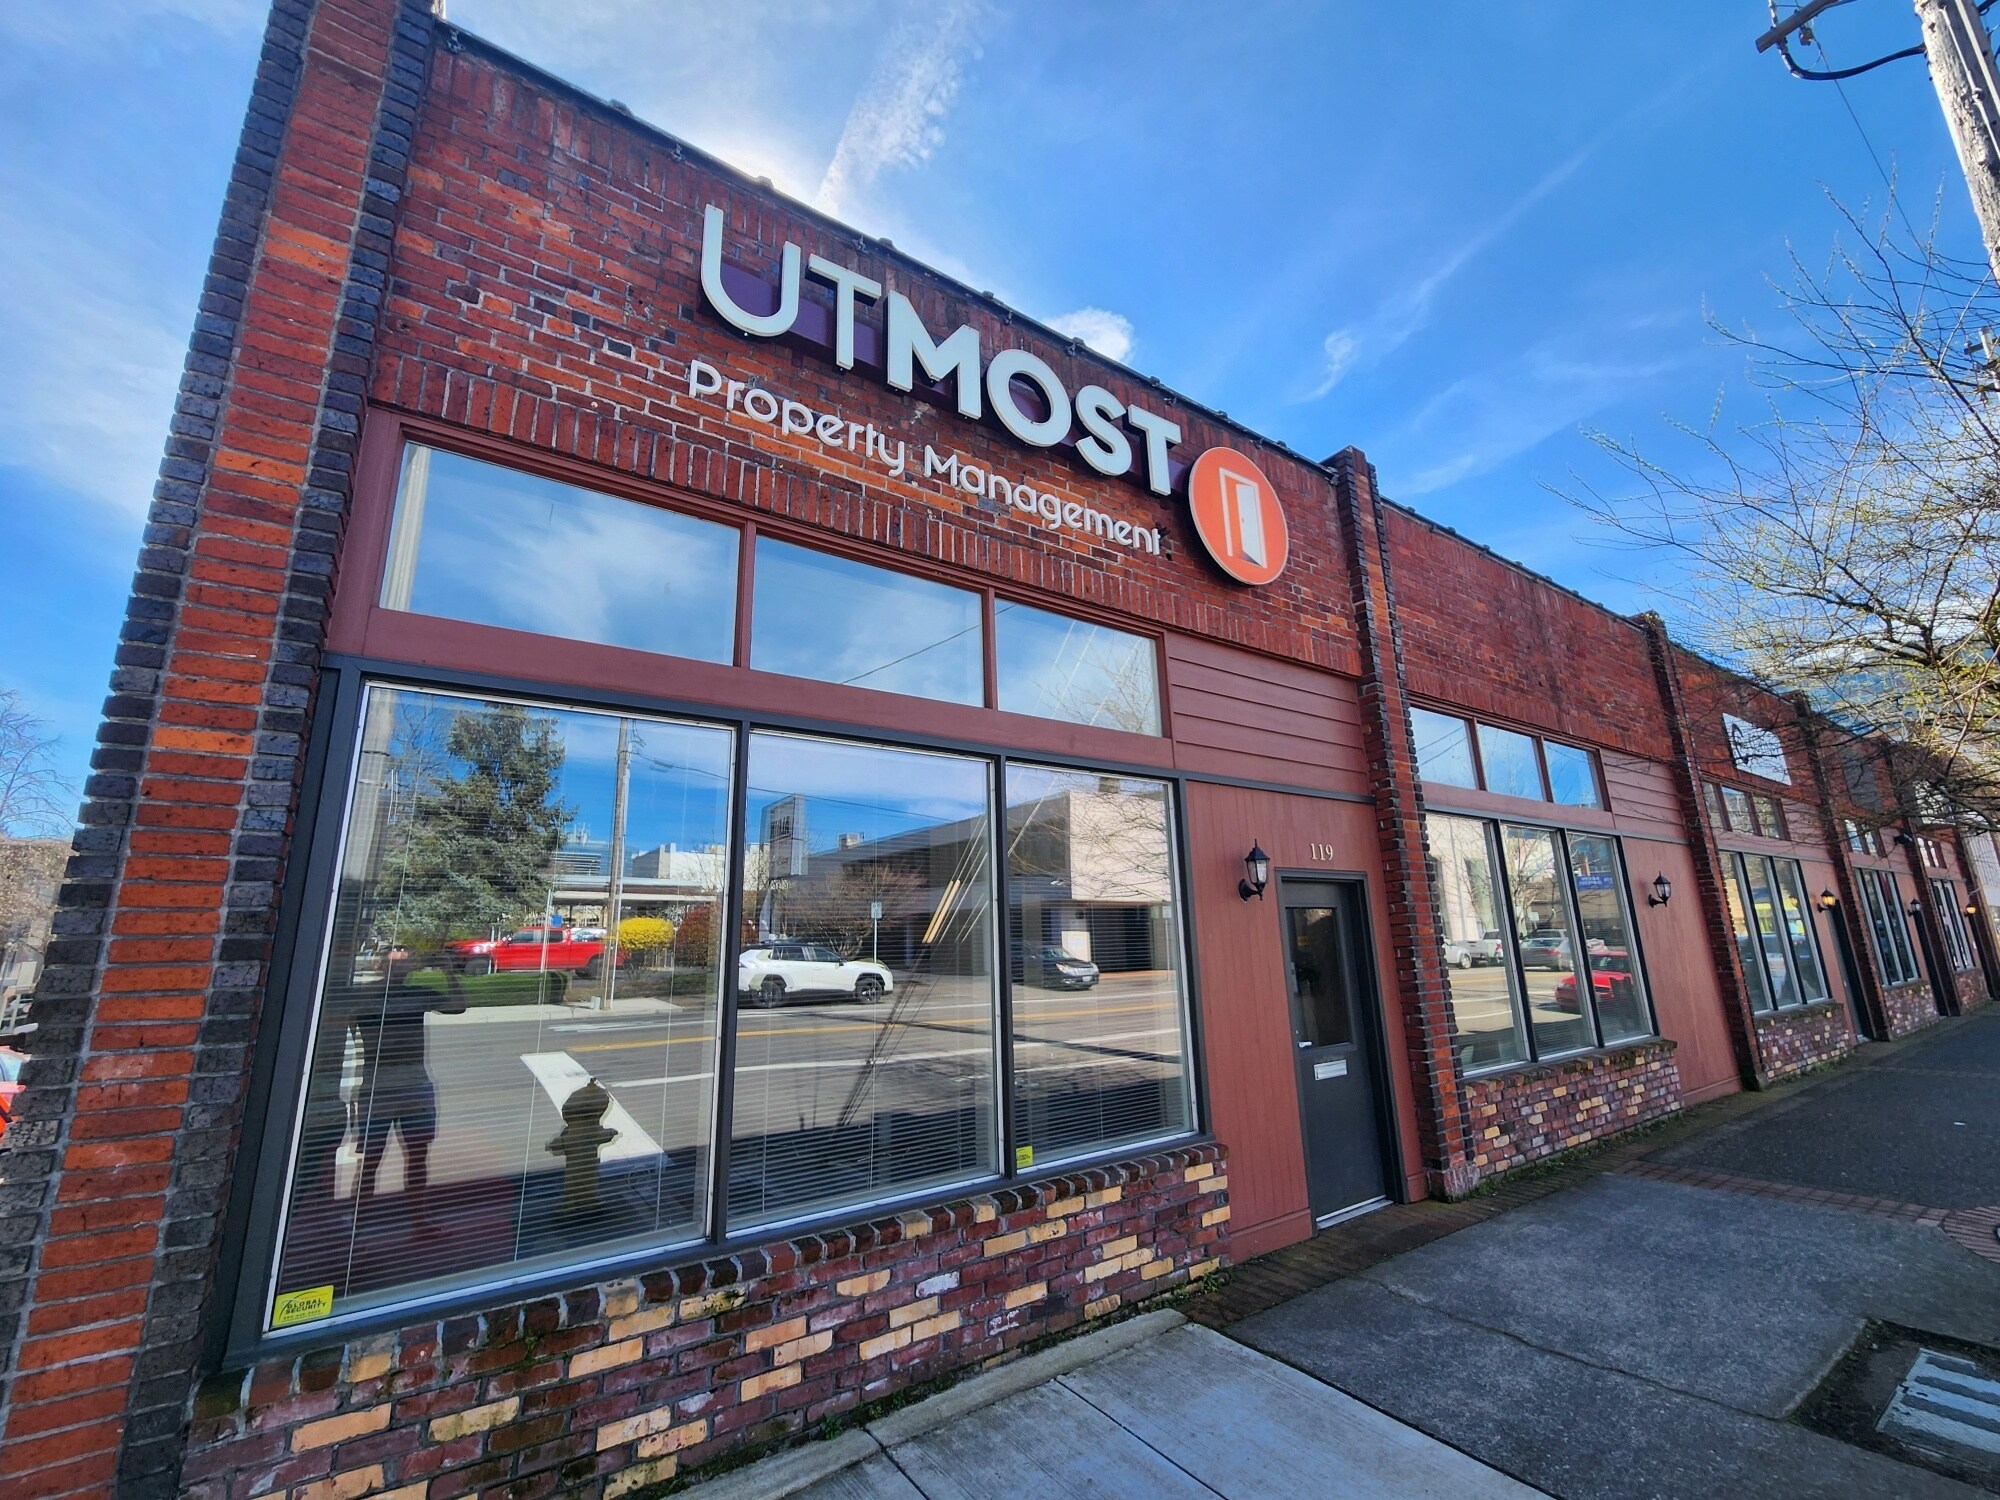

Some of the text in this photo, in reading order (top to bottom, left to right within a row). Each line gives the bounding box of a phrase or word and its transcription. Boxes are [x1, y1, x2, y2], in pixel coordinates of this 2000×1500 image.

[701, 203, 1182, 496] UTMOST
[689, 359, 1161, 556] Property Management
[1310, 843, 1334, 861] 119
[285, 1302, 326, 1314] SECURITY
[286, 1298, 322, 1309] GLOBAL
